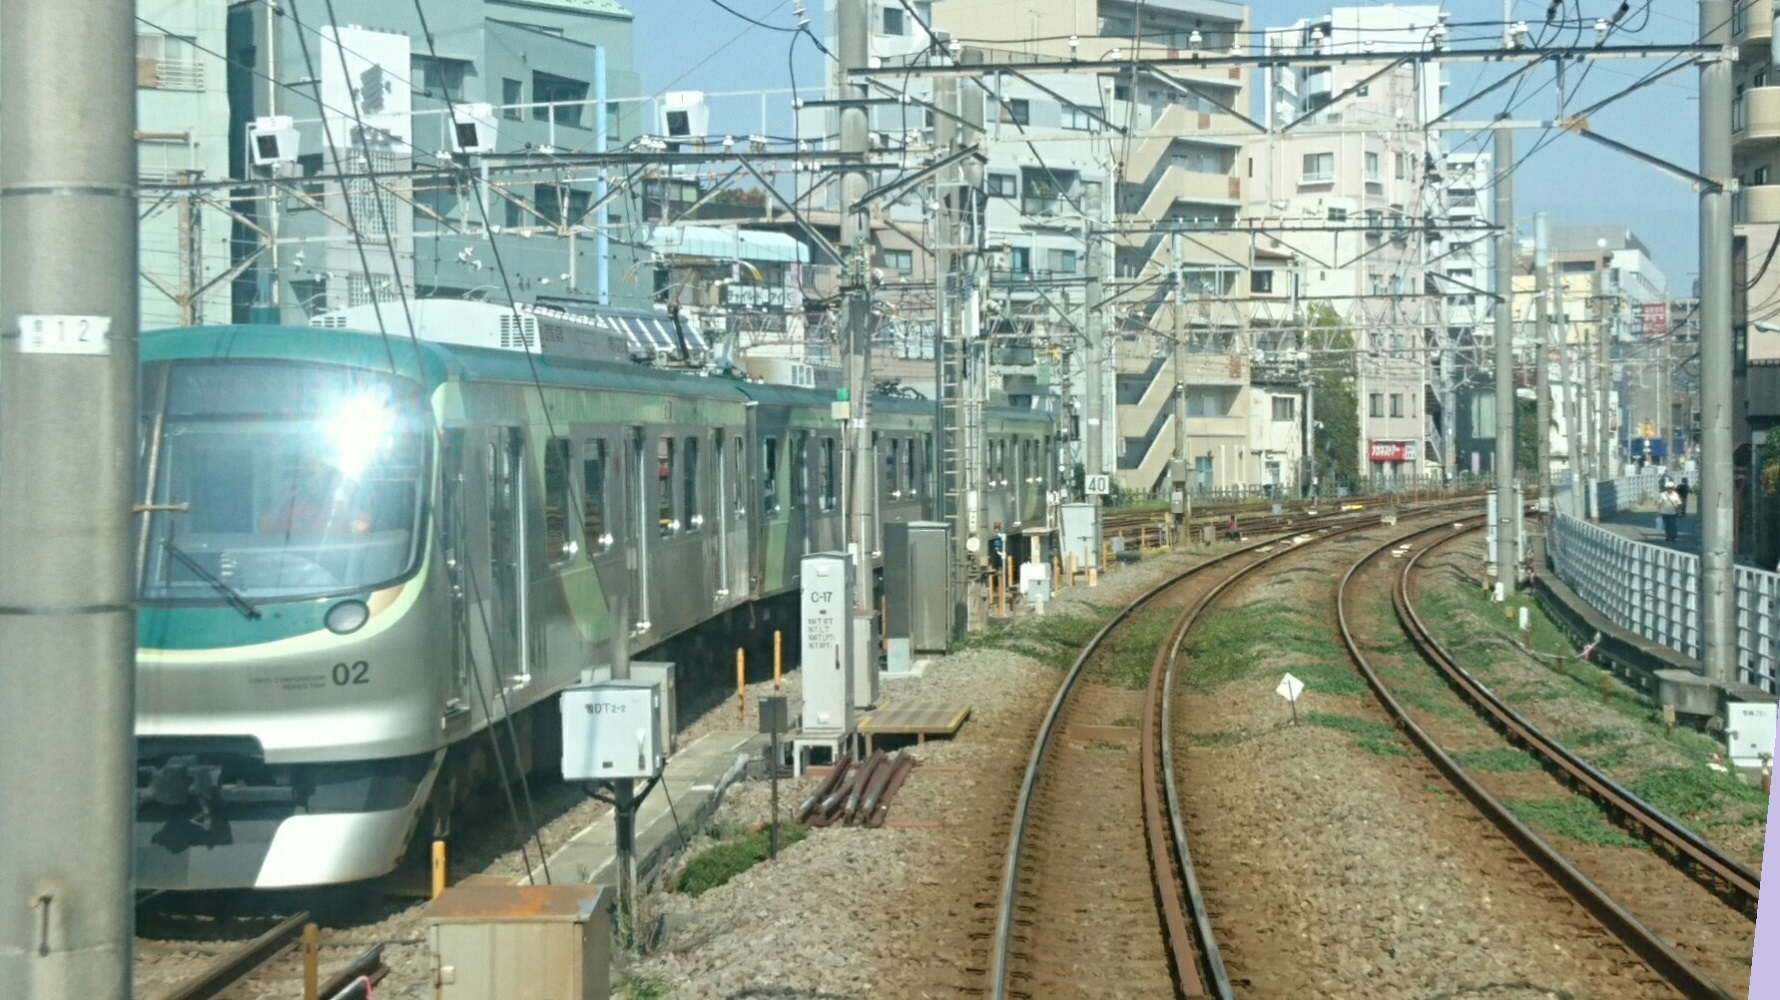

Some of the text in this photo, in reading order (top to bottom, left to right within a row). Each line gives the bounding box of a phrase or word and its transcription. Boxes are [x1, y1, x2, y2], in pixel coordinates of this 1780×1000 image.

[467, 105, 475, 116] 2
[1088, 477, 1106, 492] 40
[810, 591, 833, 604] C-17
[332, 660, 370, 686] 02
